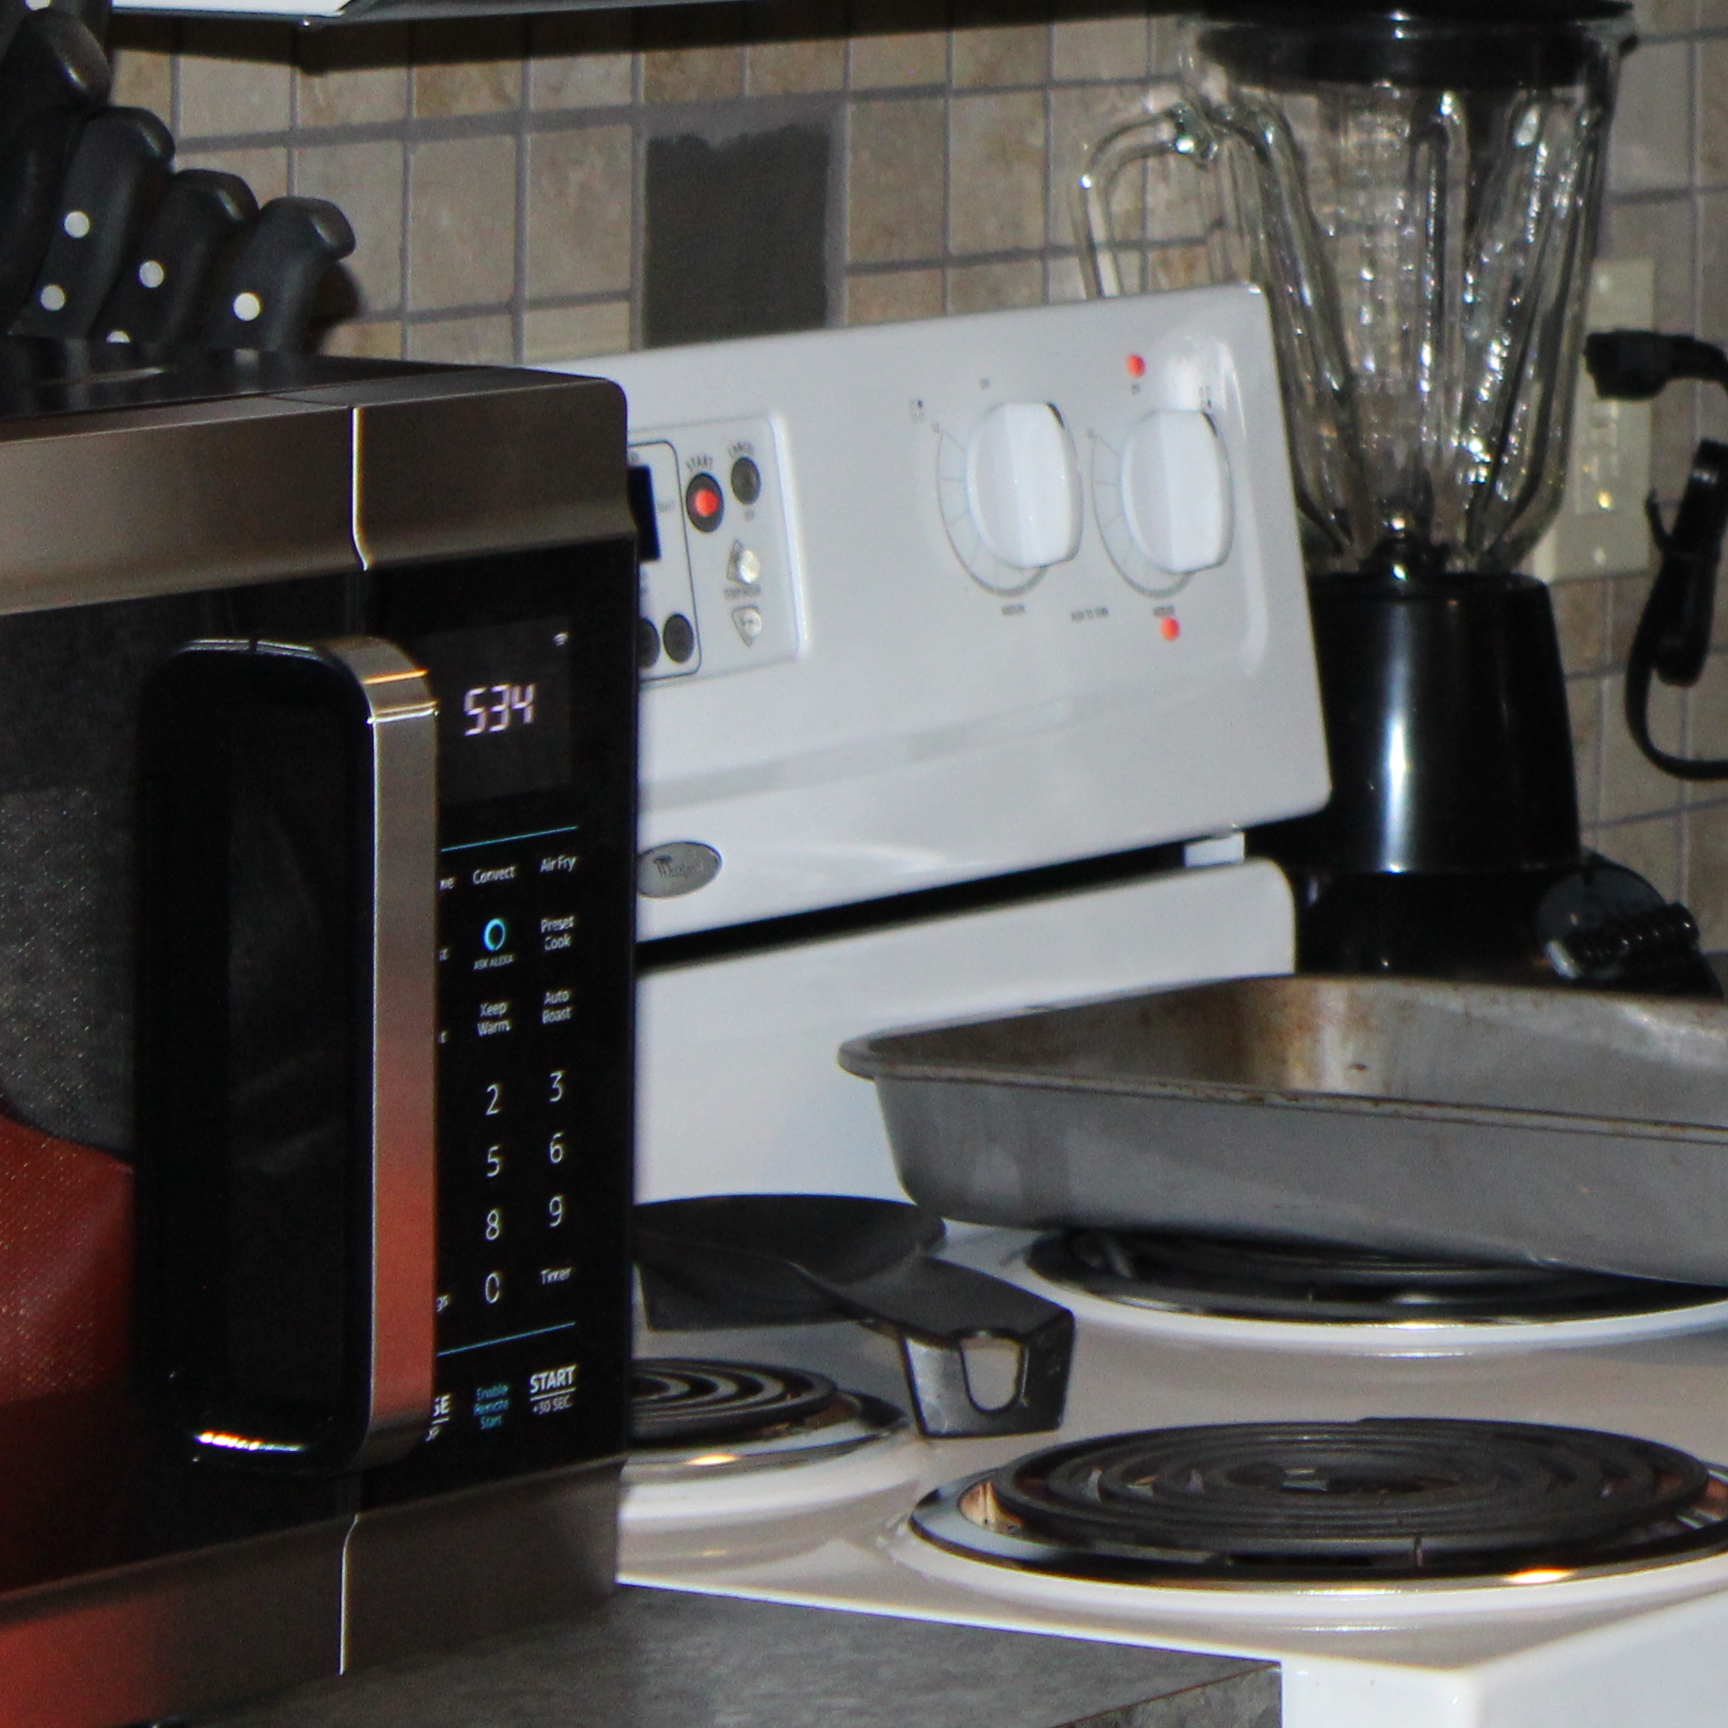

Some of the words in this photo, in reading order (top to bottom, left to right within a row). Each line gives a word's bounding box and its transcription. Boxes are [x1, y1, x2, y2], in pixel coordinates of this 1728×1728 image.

[473, 866, 516, 885] Convect
[541, 916, 575, 933] Preset
[545, 933, 571, 951] Cook
[544, 990, 570, 1005] Auto
[477, 1020, 511, 1037] Warm
[486, 1084, 500, 1115] 2
[550, 1071, 563, 1102] 3
[486, 1146, 500, 1177] 5
[549, 1132, 563, 1163] 6
[485, 1209, 500, 1241] 8
[549, 1195, 563, 1227] 9
[485, 1272, 500, 1304] 0
[530, 1365, 576, 1395] START
